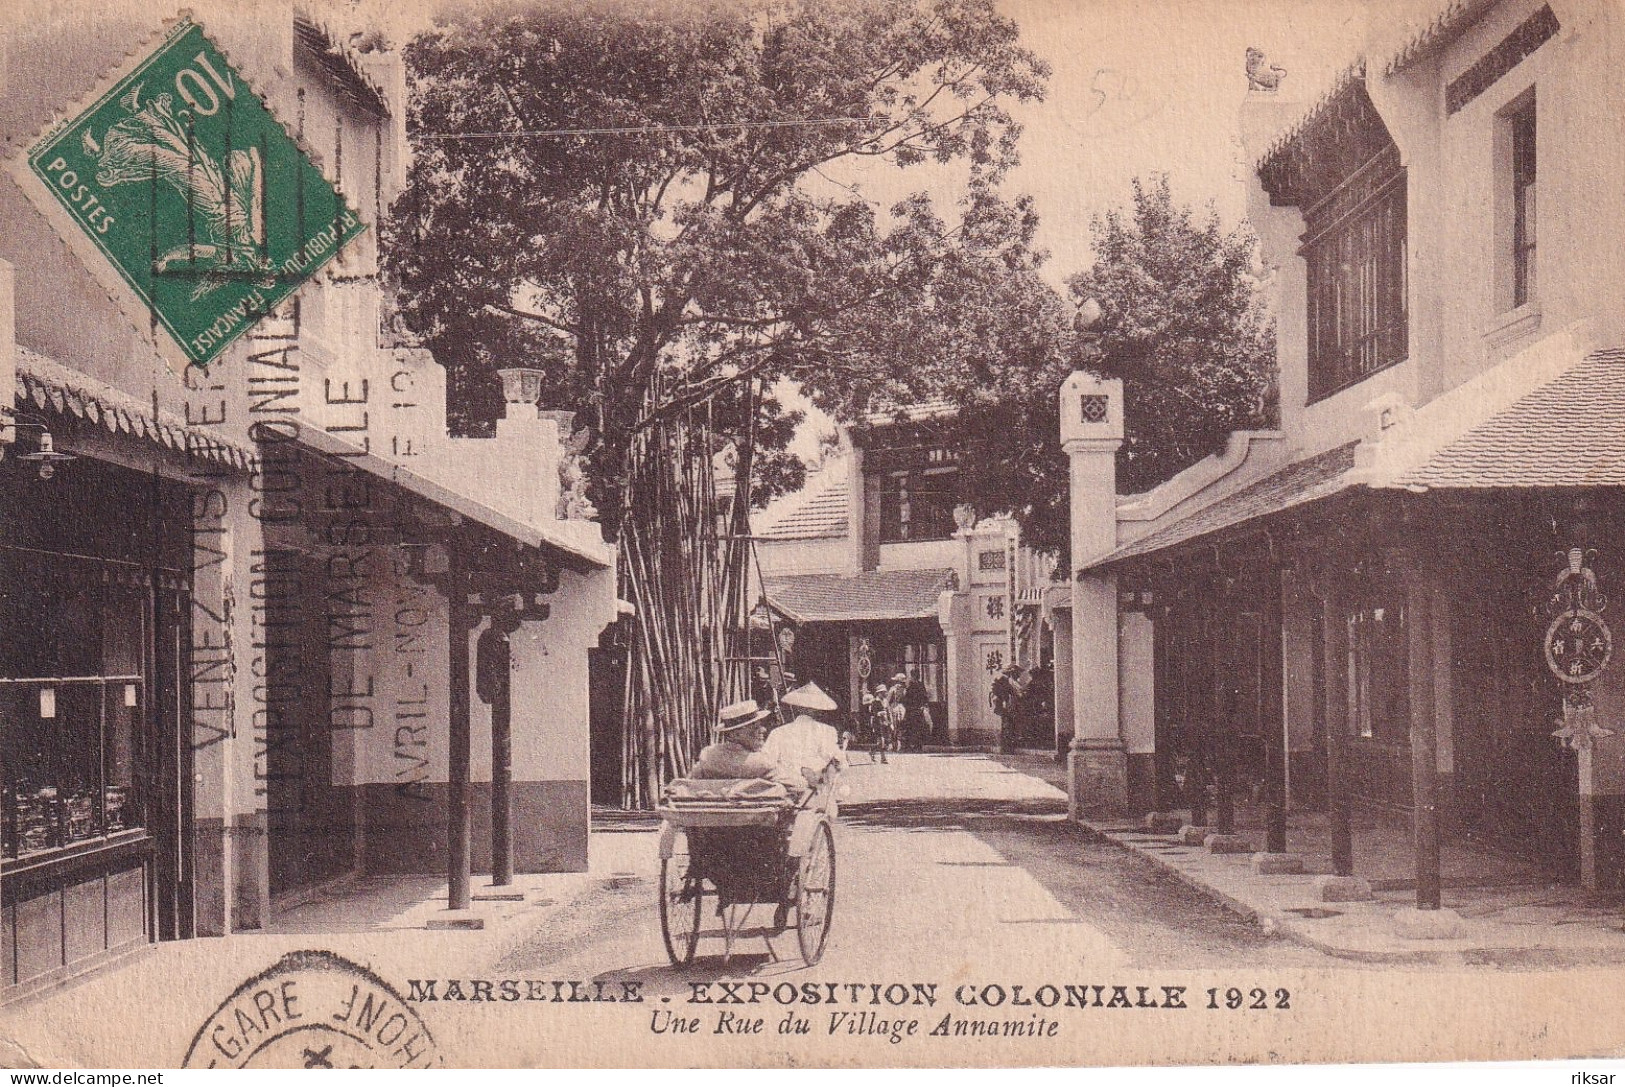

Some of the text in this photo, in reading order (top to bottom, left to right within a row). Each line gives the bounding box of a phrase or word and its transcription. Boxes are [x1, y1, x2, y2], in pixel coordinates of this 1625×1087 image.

[45, 156, 116, 236] POSTES
[324, 377, 374, 730] DE MARSEILLE
